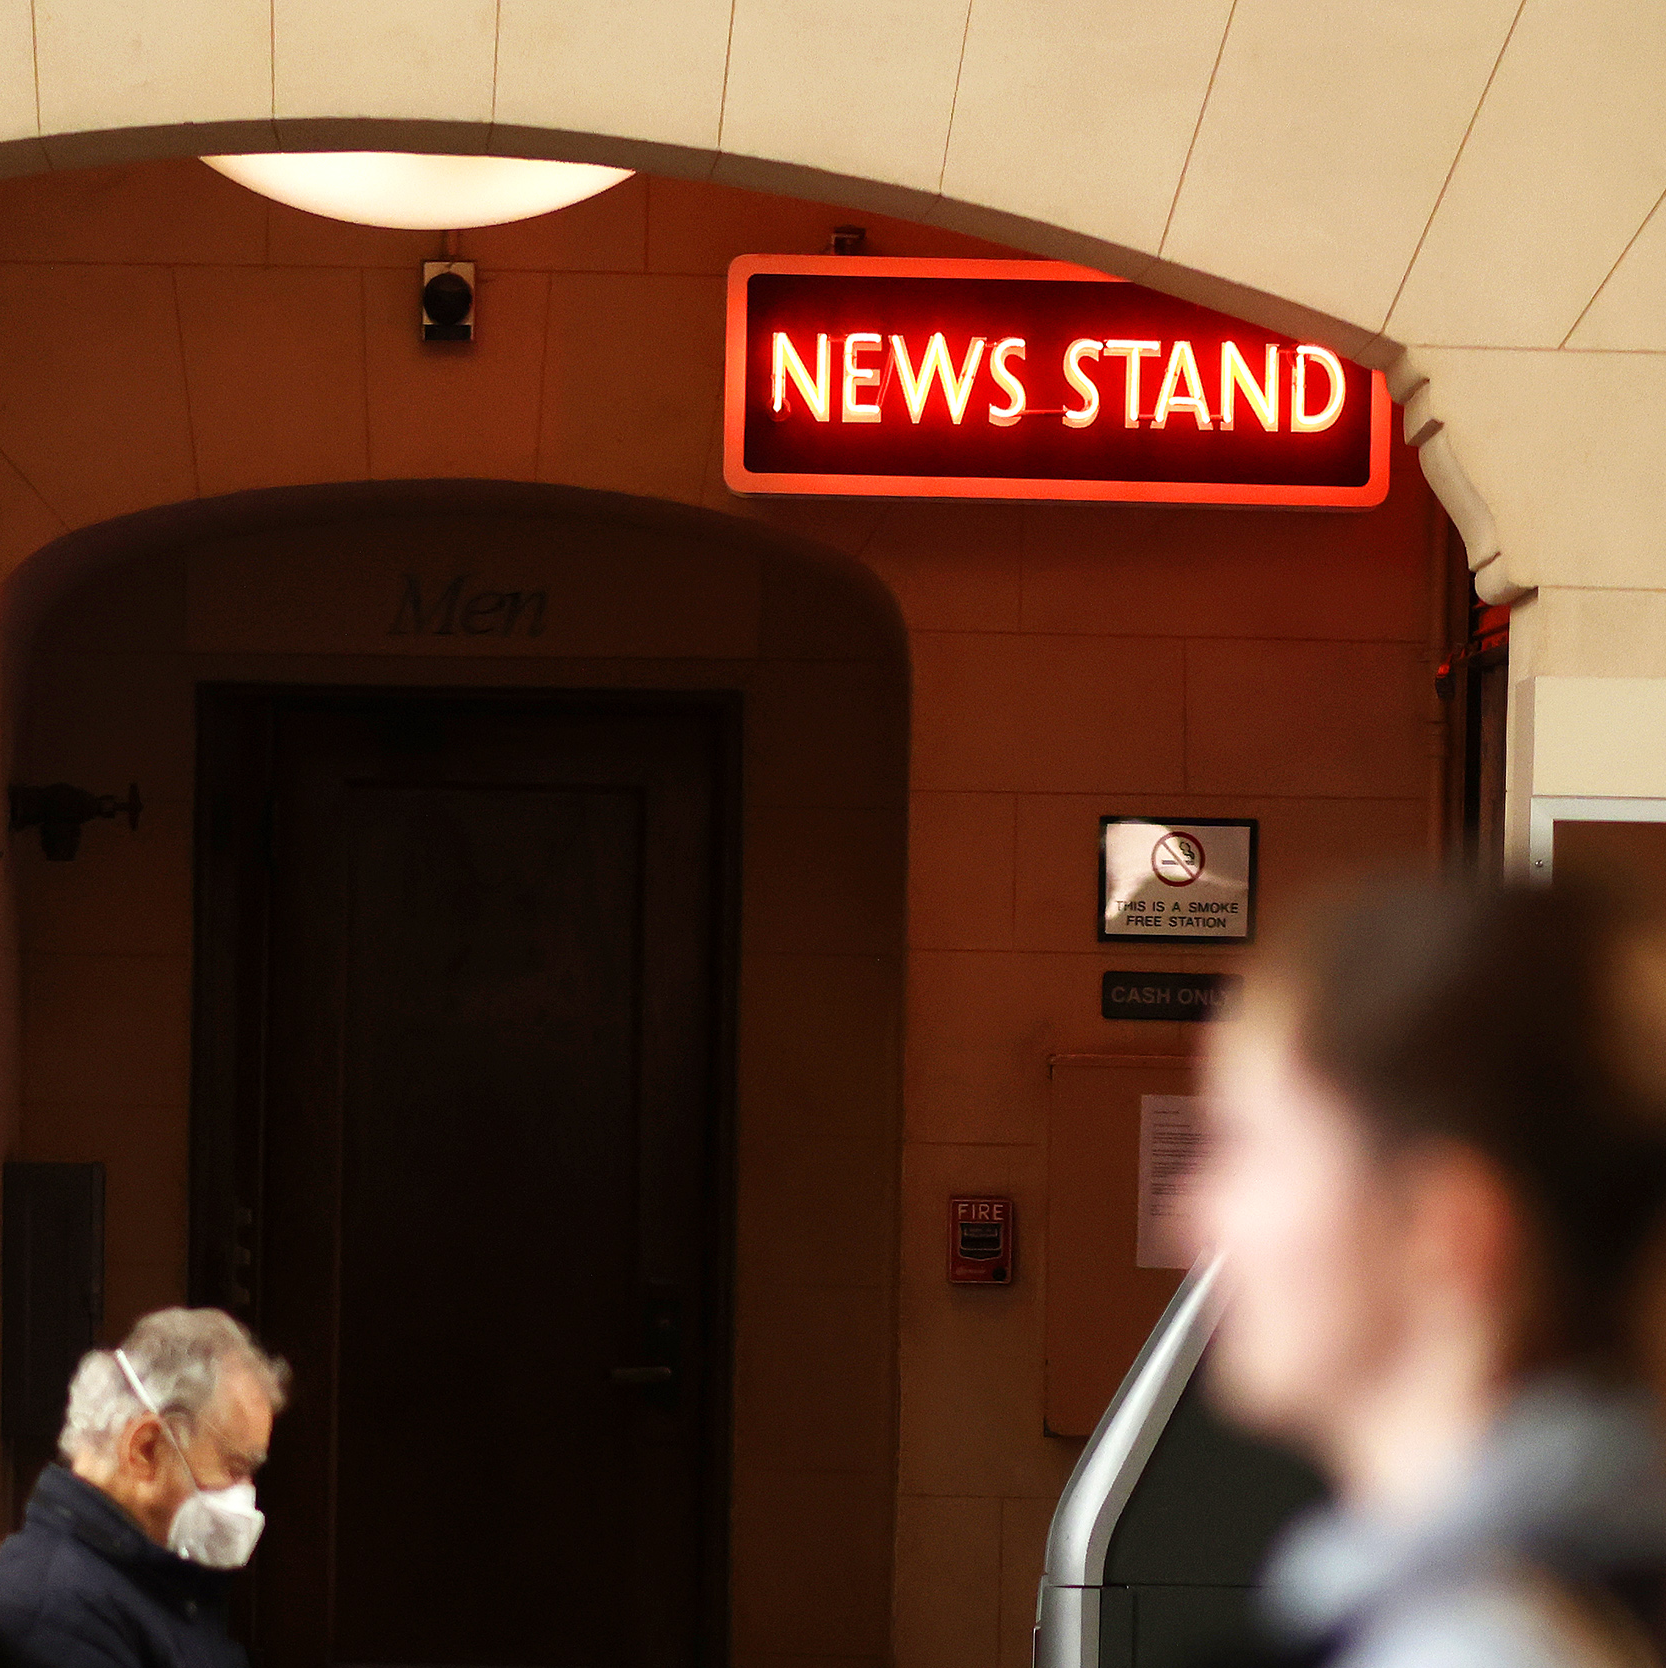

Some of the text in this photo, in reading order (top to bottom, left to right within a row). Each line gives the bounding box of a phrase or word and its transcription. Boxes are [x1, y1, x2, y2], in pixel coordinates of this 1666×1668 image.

[770, 331, 1346, 434] NEWS STAND
[386, 570, 548, 636] Men
[1116, 900, 1239, 914] THIS IS A SMOKE
[1127, 916, 1226, 928] FREE STATION
[1111, 986, 1226, 1006] CASH ONL
[958, 1204, 1004, 1220] FIRE
